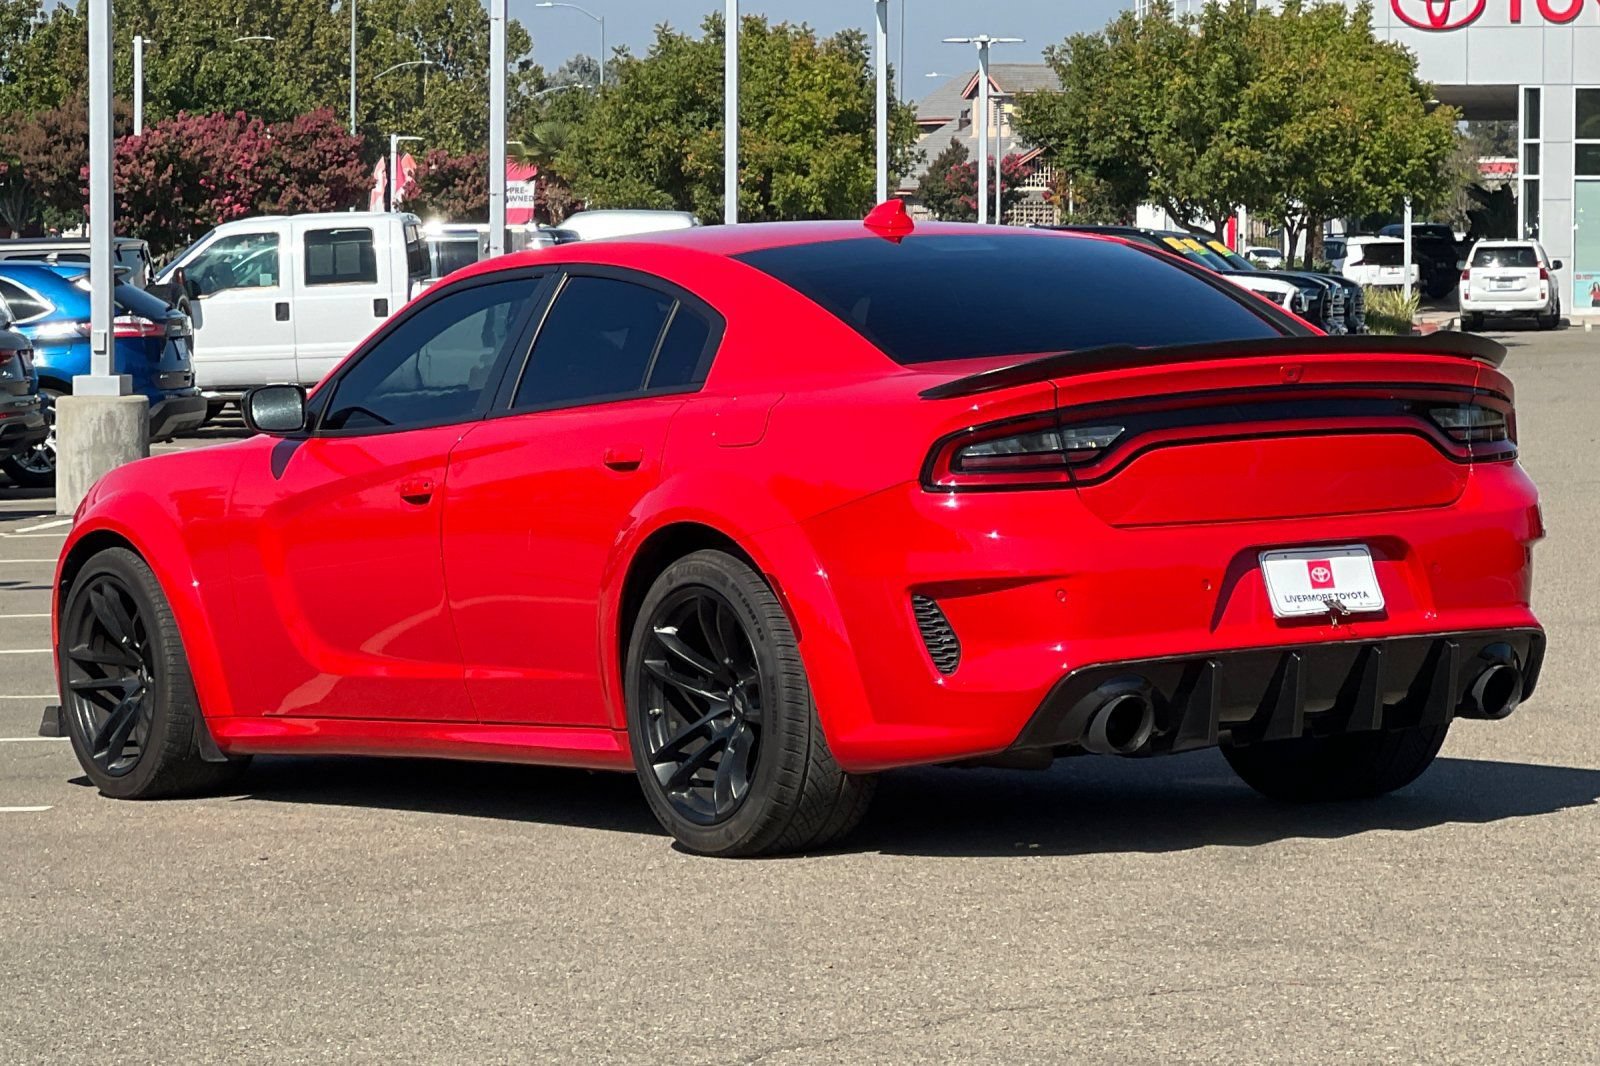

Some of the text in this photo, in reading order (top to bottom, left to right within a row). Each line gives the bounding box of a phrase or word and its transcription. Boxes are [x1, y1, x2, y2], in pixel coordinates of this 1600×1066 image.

[509, 186, 528, 194] PRE-
[1284, 591, 1370, 603] LIVERMORE TOYOTA
